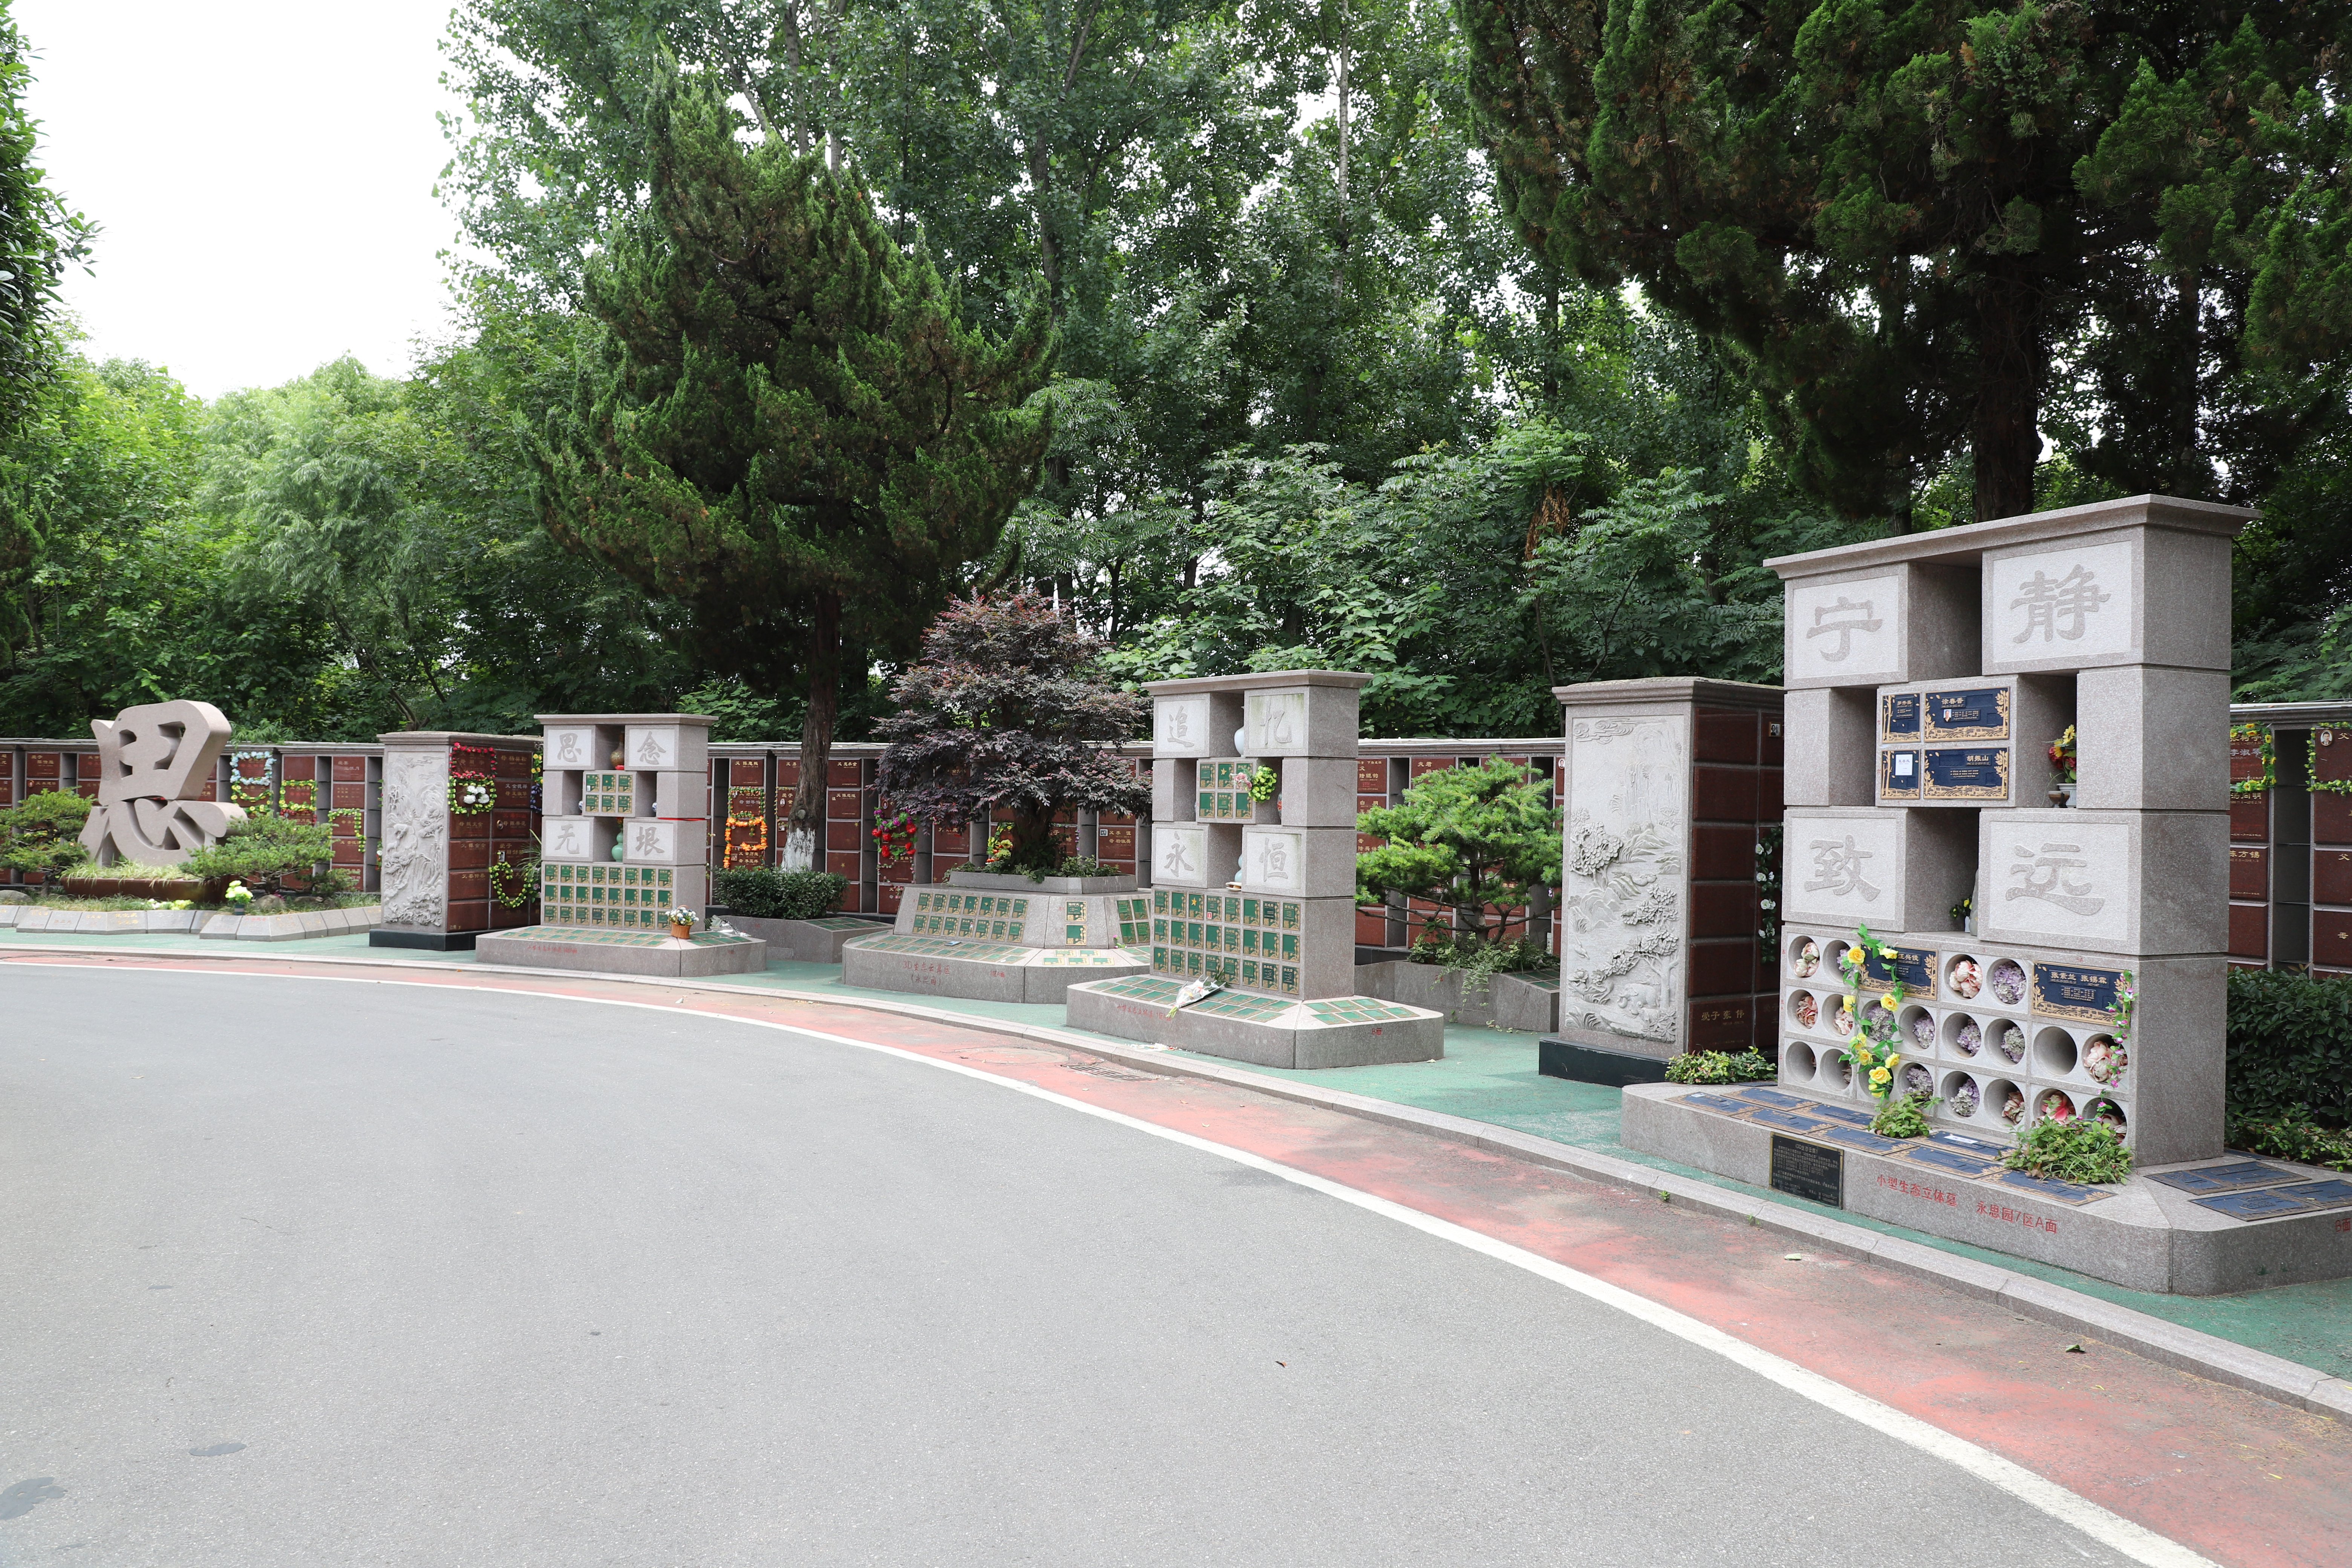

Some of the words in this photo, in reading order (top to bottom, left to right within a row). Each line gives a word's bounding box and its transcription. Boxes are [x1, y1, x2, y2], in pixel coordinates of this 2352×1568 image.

[1807, 597, 1882, 662] 宁
[2011, 564, 2111, 644] 静
[557, 732, 582, 763] 思
[637, 730, 666, 765] 念
[1167, 705, 1195, 748] 追
[1260, 700, 1292, 745] 忆
[555, 823, 580, 854] 无
[635, 825, 665, 856] 垠
[1164, 831, 1194, 877] 永
[1259, 837, 1288, 882] 恒
[1805, 835, 1881, 902] 致
[2006, 842, 2105, 916] 远
[1876, 1174, 1958, 1207] 小型生态立体墓
[1976, 1200, 2058, 1234] 永思园7区A面
